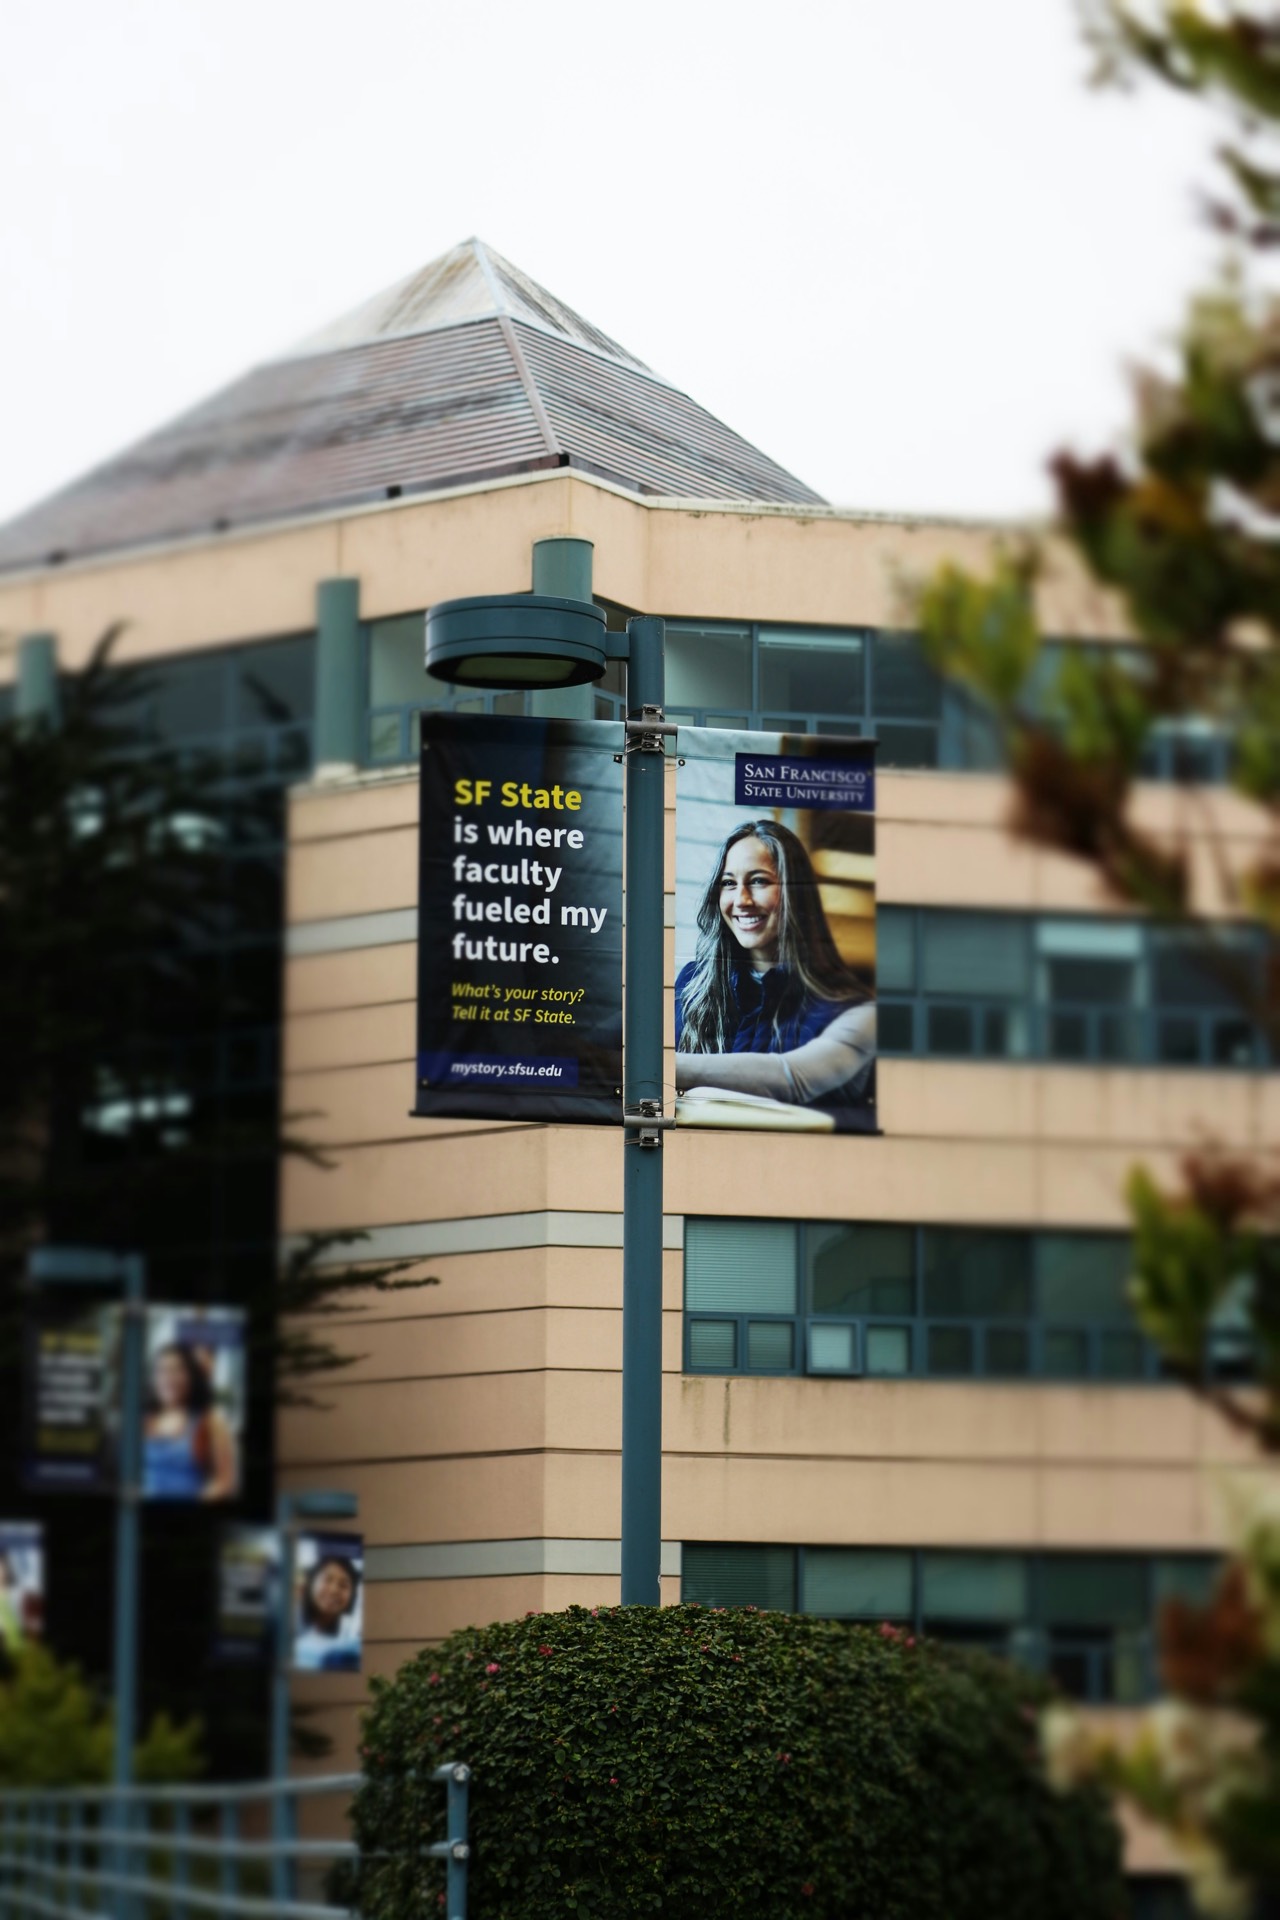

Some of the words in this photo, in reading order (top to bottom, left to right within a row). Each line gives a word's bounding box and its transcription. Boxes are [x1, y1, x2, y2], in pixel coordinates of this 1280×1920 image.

[744, 763, 775, 779] SAN
[454, 778, 491, 806] SF
[501, 781, 582, 811] State
[744, 784, 783, 798] STATE
[453, 816, 478, 844] is
[488, 820, 584, 849] where
[453, 855, 562, 892] faculty
[453, 895, 550, 925] fueled
[560, 905, 607, 933] my
[452, 933, 559, 964] future.
[451, 982, 501, 999] What's
[504, 988, 538, 1002] your
[541, 988, 584, 1004] story?
[452, 1005, 477, 1020] Tell
[479, 1006, 491, 1020] it
[493, 1008, 509, 1021] at
[512, 1008, 531, 1023] SF
[534, 1009, 576, 1024] State.
[451, 1062, 562, 1077] mystory.sfsu.edu
